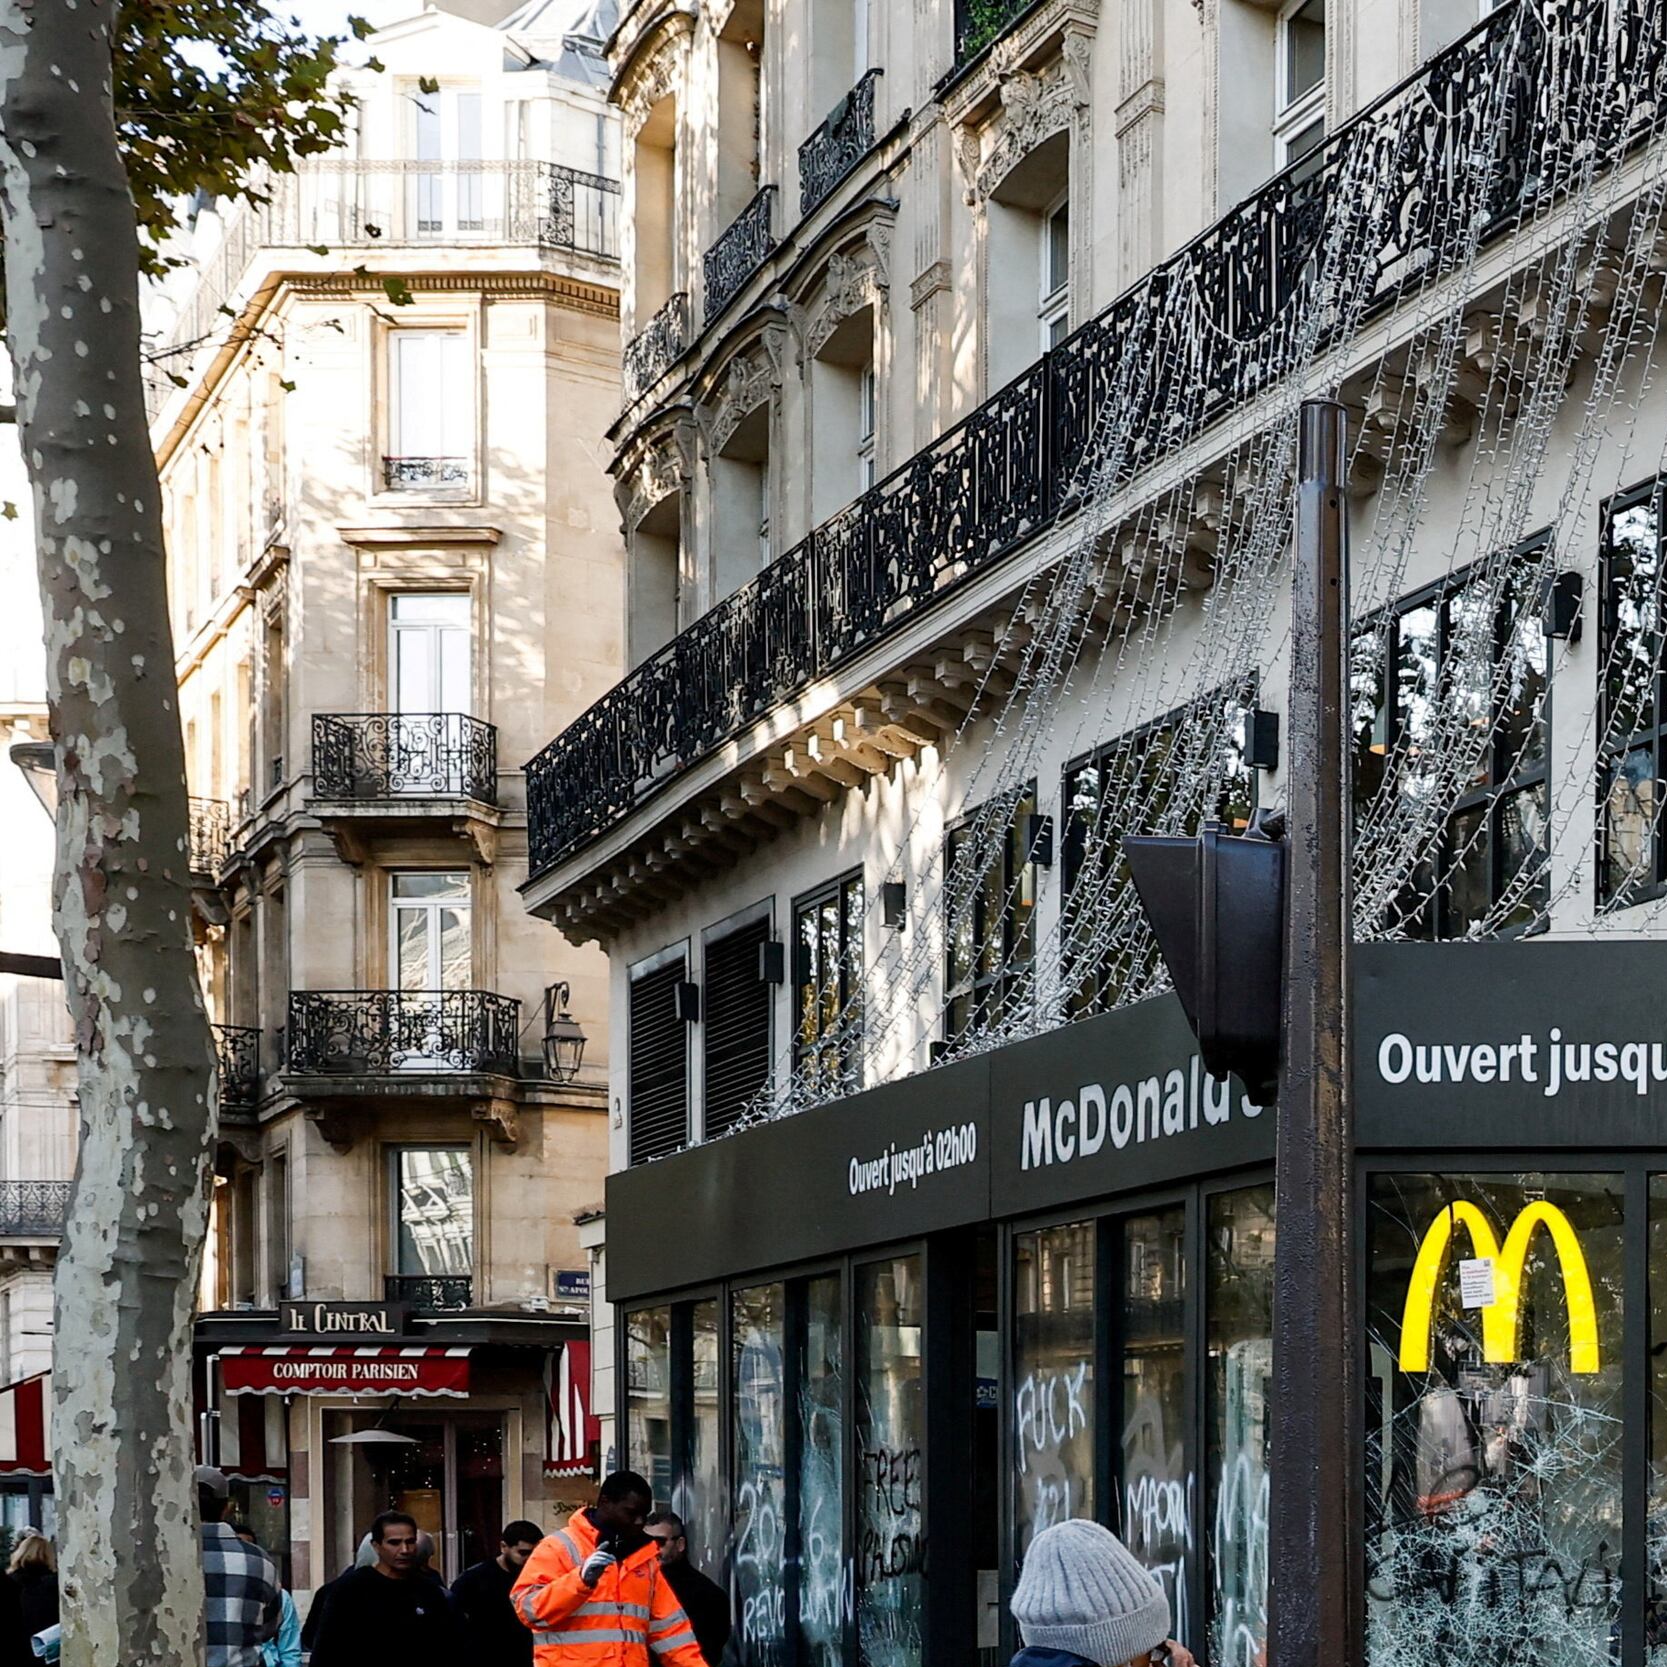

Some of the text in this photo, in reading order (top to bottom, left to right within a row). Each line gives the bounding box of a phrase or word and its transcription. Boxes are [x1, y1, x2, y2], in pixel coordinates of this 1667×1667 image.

[1378, 1033, 1538, 1084] Ouvert
[1021, 1054, 1265, 1171] McDonald
[848, 1121, 977, 1196] Ouvert jusqu'à 02h00
[273, 1363, 419, 1380] COMPTOIR PARISIEN
[1017, 1360, 1087, 1472] FUCK
[862, 1448, 921, 1515] FREE
